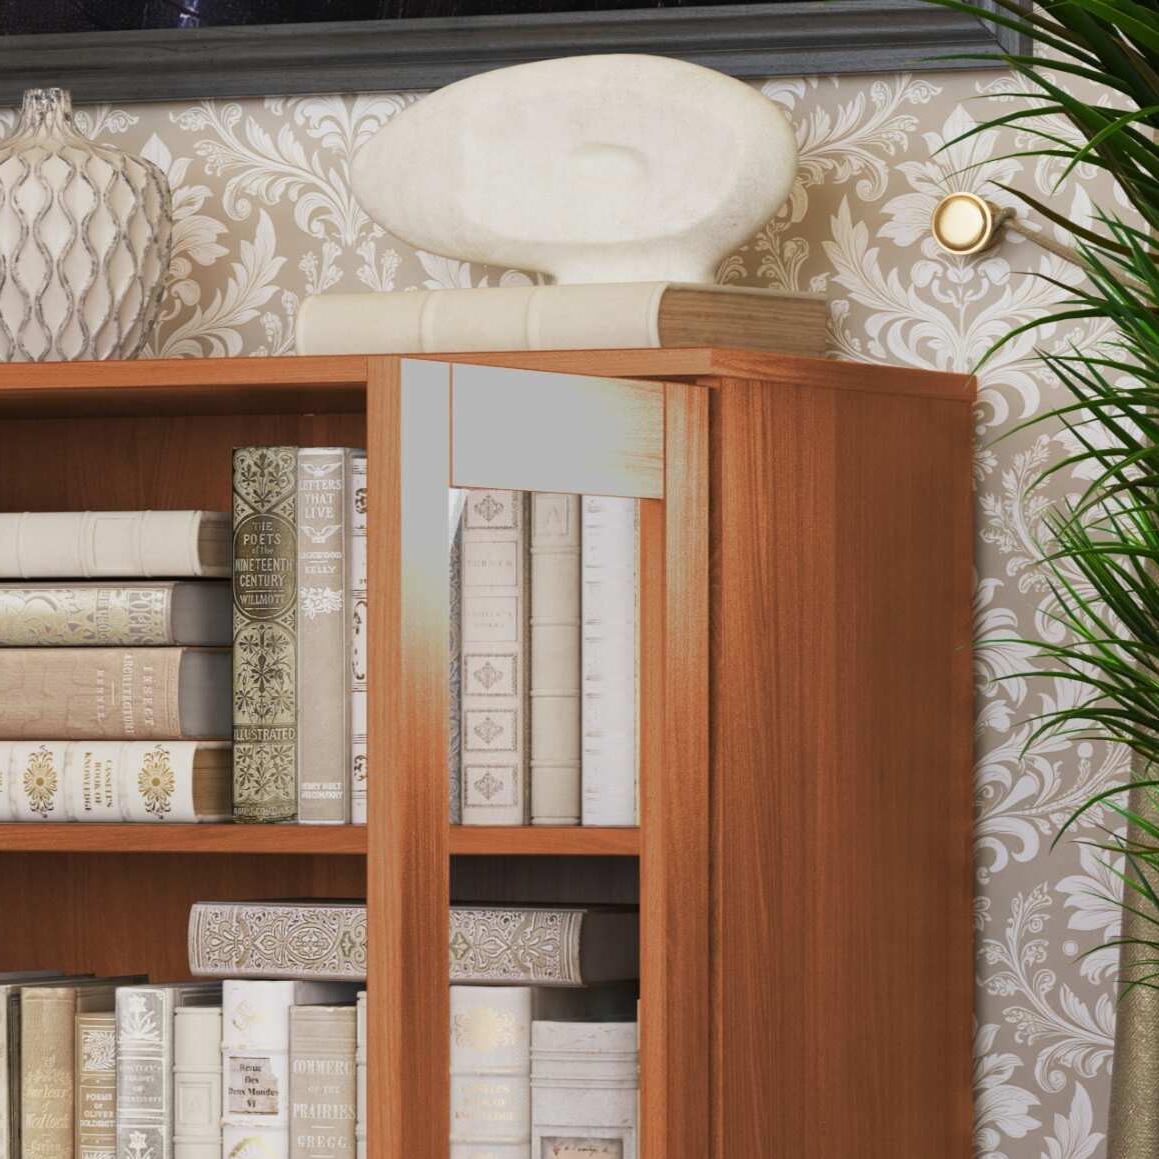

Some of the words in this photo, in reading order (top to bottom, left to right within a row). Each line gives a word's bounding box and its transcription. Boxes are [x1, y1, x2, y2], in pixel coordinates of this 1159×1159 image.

[304, 493, 335, 504] THAT
[304, 507, 335, 519] LIVE
[242, 533, 282, 545] POETS
[233, 558, 294, 572] NINETEENTH
[239, 574, 287, 587] CENTURY
[143, 664, 155, 728] INSECT
[233, 727, 296, 741] ILLUSTRATED
[83, 752, 93, 812] KNOWLEDGE
[94, 761, 102, 790] BOOK
[292, 1103, 356, 1120] PRAIRIES
